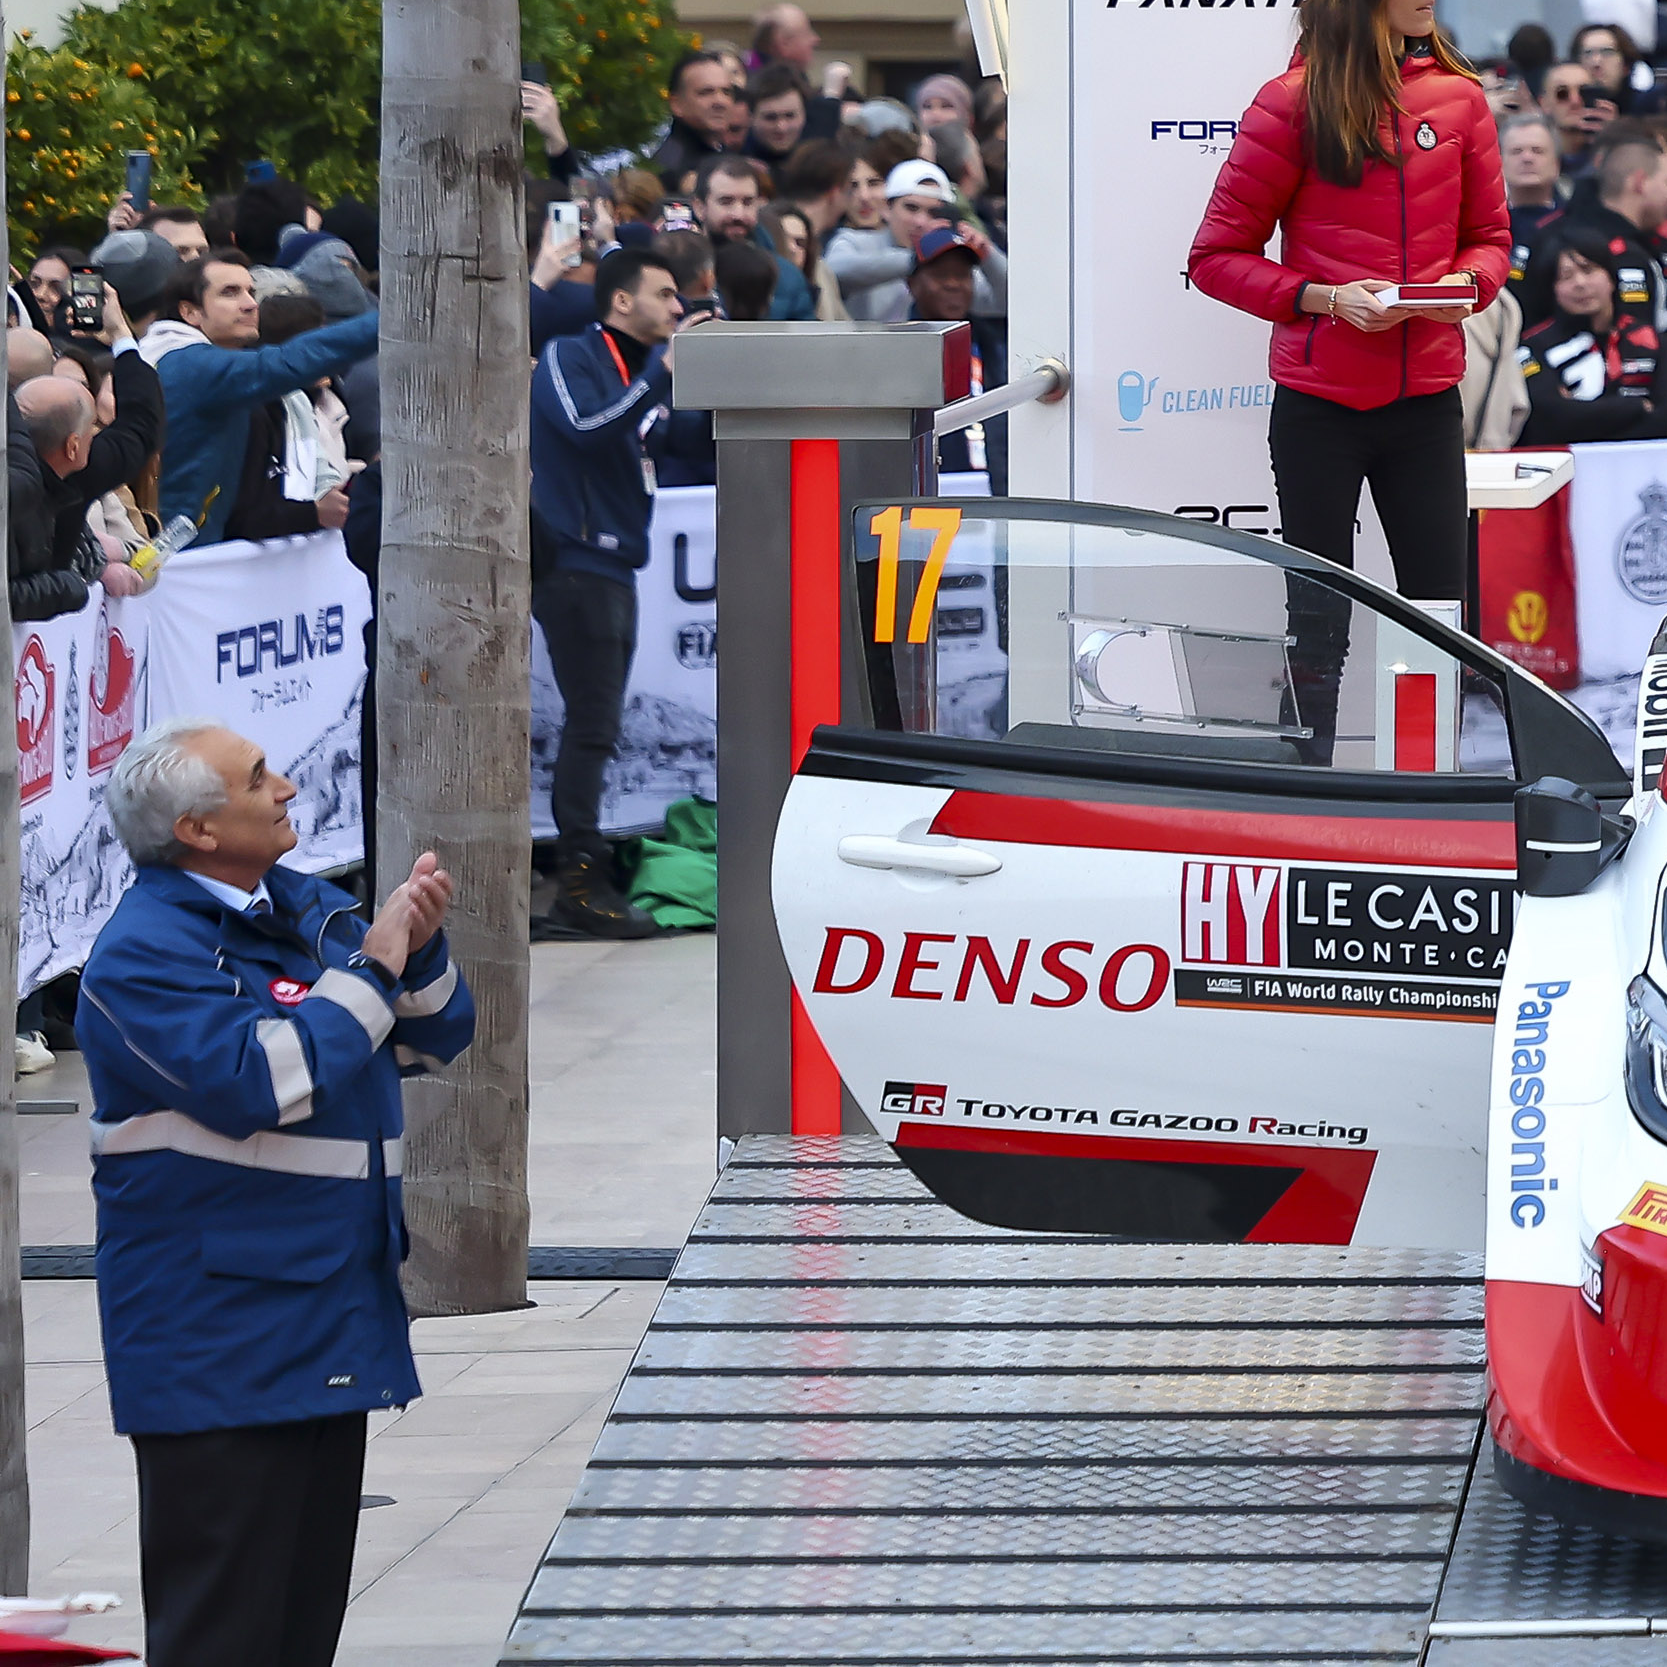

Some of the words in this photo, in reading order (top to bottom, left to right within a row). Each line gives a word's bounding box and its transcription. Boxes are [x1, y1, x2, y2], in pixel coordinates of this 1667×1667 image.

[1163, 387, 1226, 414] CLEAN
[870, 506, 962, 643] 17
[1185, 863, 1279, 963] HY
[1297, 880, 1352, 926] LE
[812, 926, 1170, 1013] DENSO
[1254, 980, 1282, 996] FIA
[1288, 982, 1336, 1000] World
[1342, 985, 1382, 1005] Rally
[1389, 988, 1498, 1010] Championshi
[957, 1098, 1099, 1125] TOYOTA
[1110, 1110, 1239, 1133] GAZOO
[1249, 1115, 1368, 1145] Racing
[1509, 980, 1571, 1229] Panasonic
